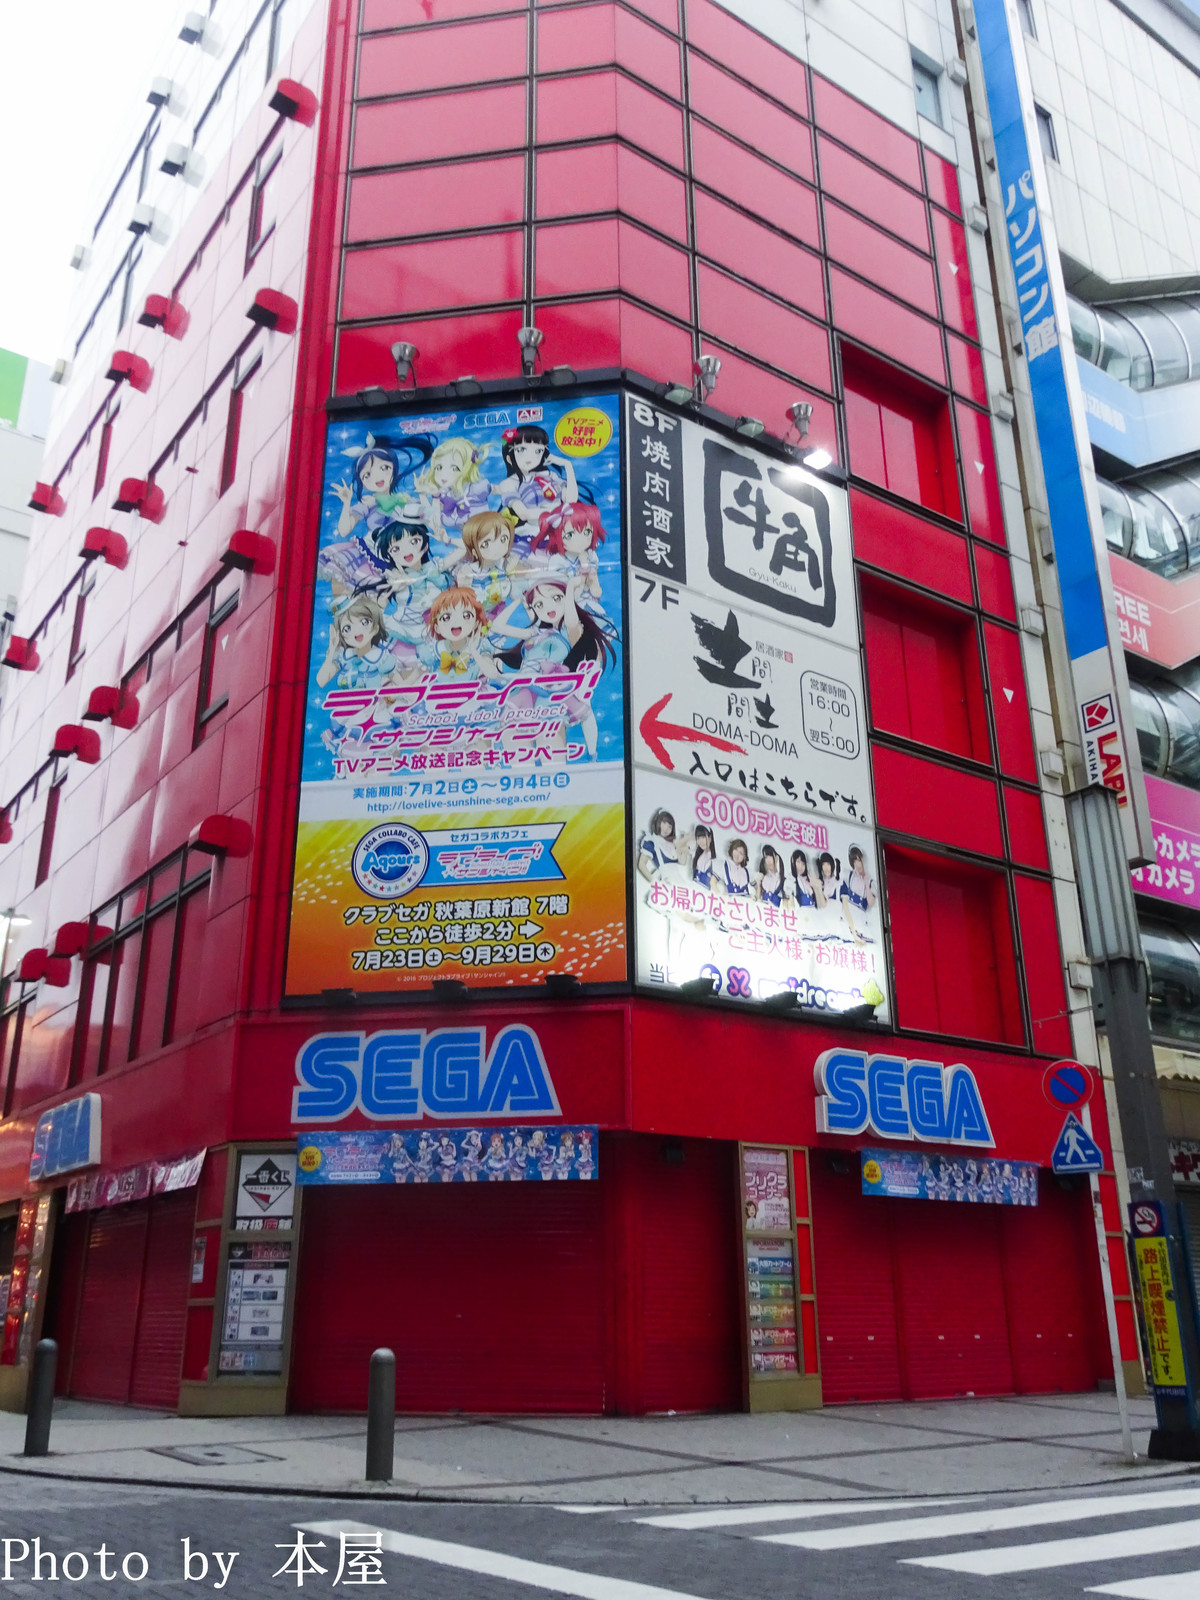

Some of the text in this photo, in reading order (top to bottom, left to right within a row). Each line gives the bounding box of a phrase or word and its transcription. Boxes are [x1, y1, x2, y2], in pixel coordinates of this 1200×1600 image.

[1006, 170, 1059, 362] パソコン館
[464, 411, 510, 429] SEGA
[633, 403, 678, 434] 8F
[572, 426, 596, 437] 好評
[641, 435, 674, 569] 焼肉酒家
[723, 480, 823, 591] 牛角
[634, 574, 680, 611] 7F
[810, 678, 847, 700] 営業時間
[408, 704, 567, 726] School idol project
[809, 692, 850, 717] 16:00
[692, 712, 799, 759] DOMA-DOMA
[809, 728, 854, 754] 翌5:00
[333, 744, 584, 774] TVアニメ放送記念キャンペーン
[690, 751, 867, 823] 入口はこちらです。
[367, 792, 551, 812] http://lovelive-sunshine-sega.com/
[407, 835, 420, 850] CAFE
[450, 830, 528, 842] セガコラボカフェ
[361, 851, 421, 873] Aqours
[344, 895, 569, 925] クラブセガ 秋葉原新館 7階
[650, 881, 798, 932] お帰りなさいませ
[375, 921, 515, 946] ここから徒歩2分
[292, 1024, 562, 1123] SEGA
[815, 1047, 996, 1148] SEGA
[246, 1170, 290, 1183] 一番くじ
[744, 1171, 788, 1190] プリクラ
[749, 1186, 782, 1199] コーナー
